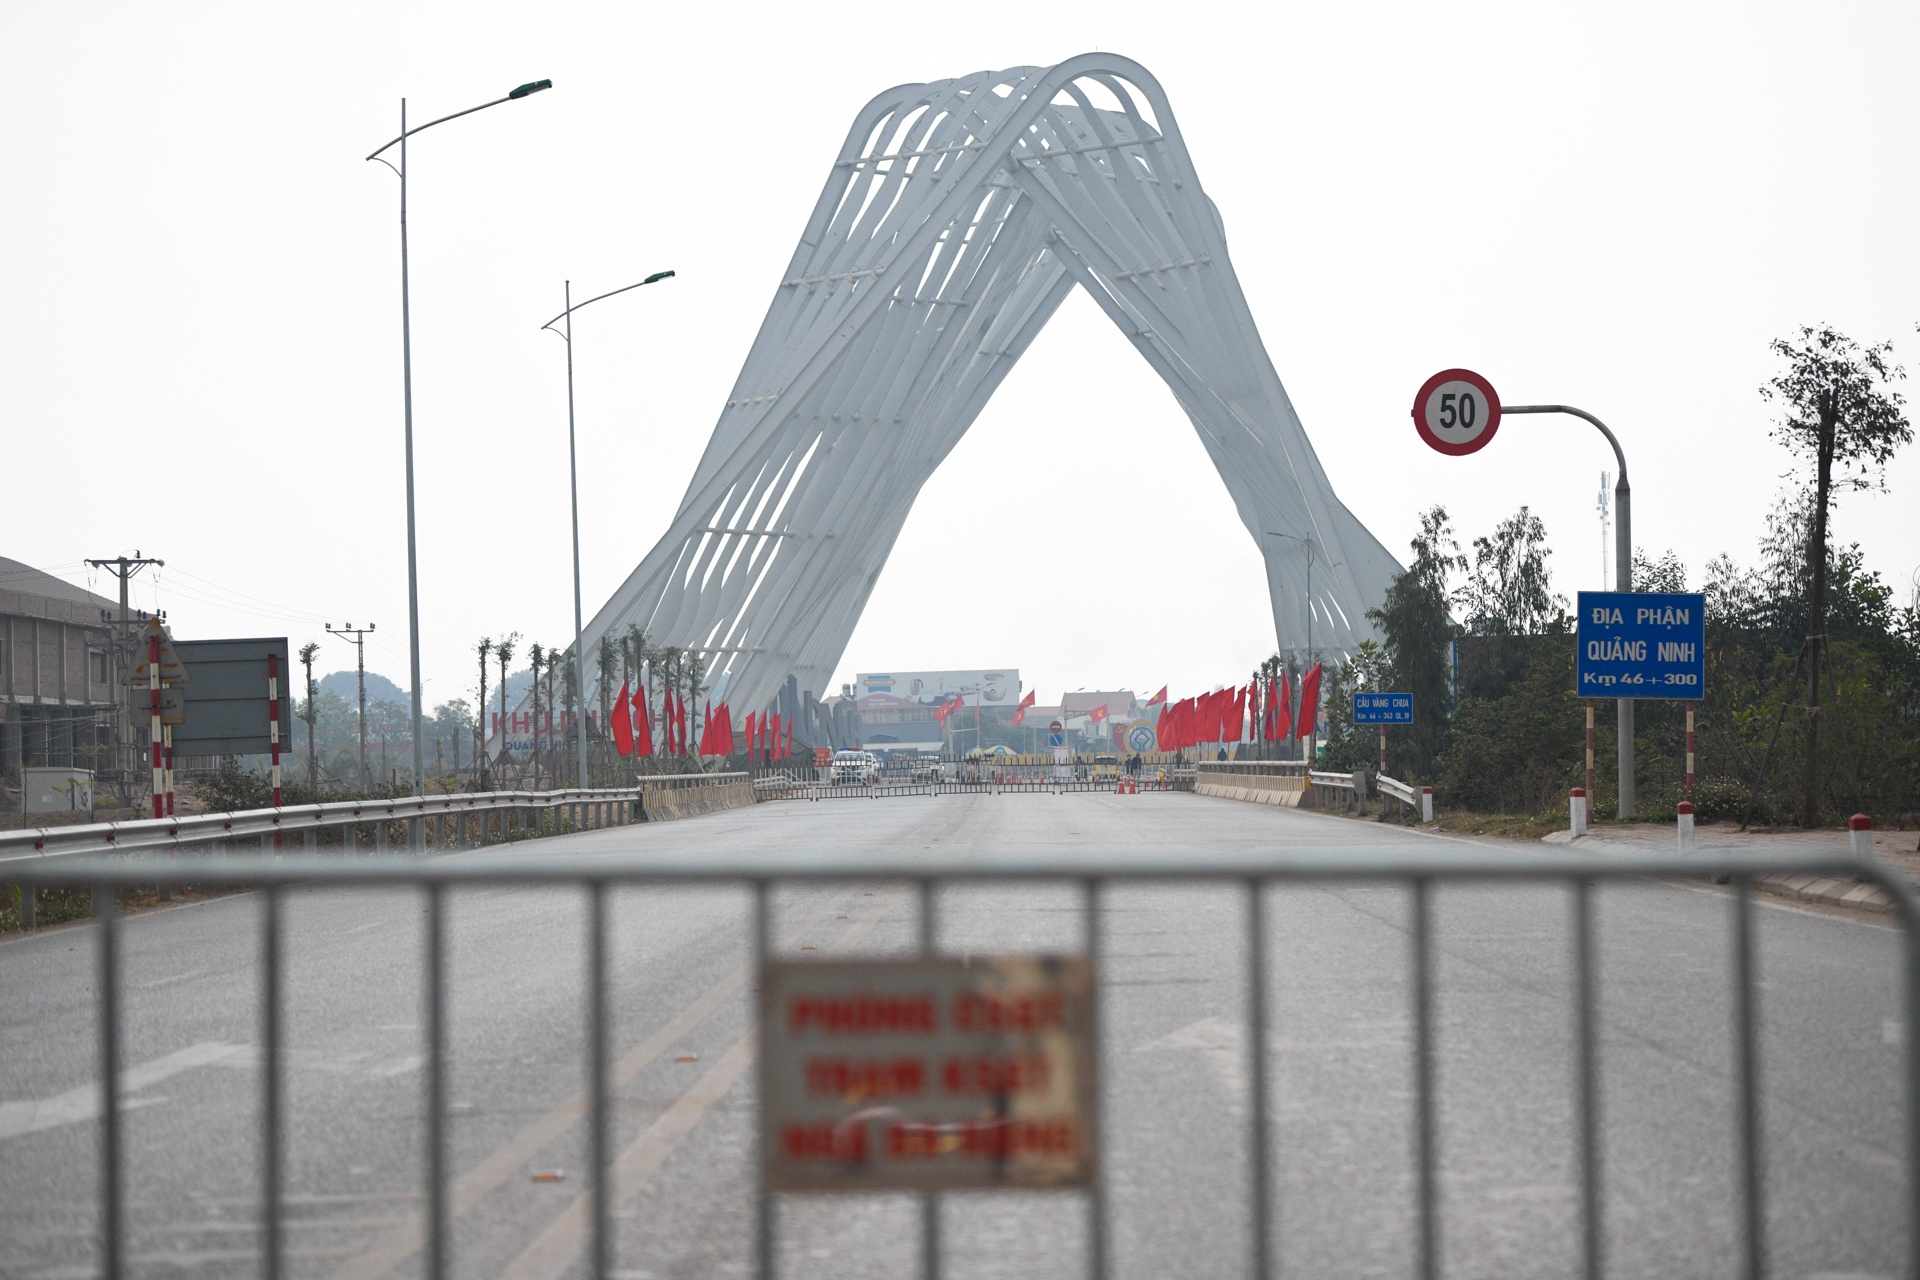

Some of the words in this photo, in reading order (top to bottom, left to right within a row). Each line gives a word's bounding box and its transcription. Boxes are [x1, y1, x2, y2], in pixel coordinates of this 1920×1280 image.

[1440, 393, 1475, 428] 50
[1591, 607, 1624, 630] ĐỊA
[1637, 606, 1689, 630] PHẬN
[1587, 636, 1647, 662] QUẢNG
[1657, 642, 1695, 662] NINH
[1584, 672, 1616, 686] Km
[1357, 696, 1369, 708] CẦU
[1372, 697, 1389, 708] VÀNG
[1392, 699, 1409, 708] CHUA
